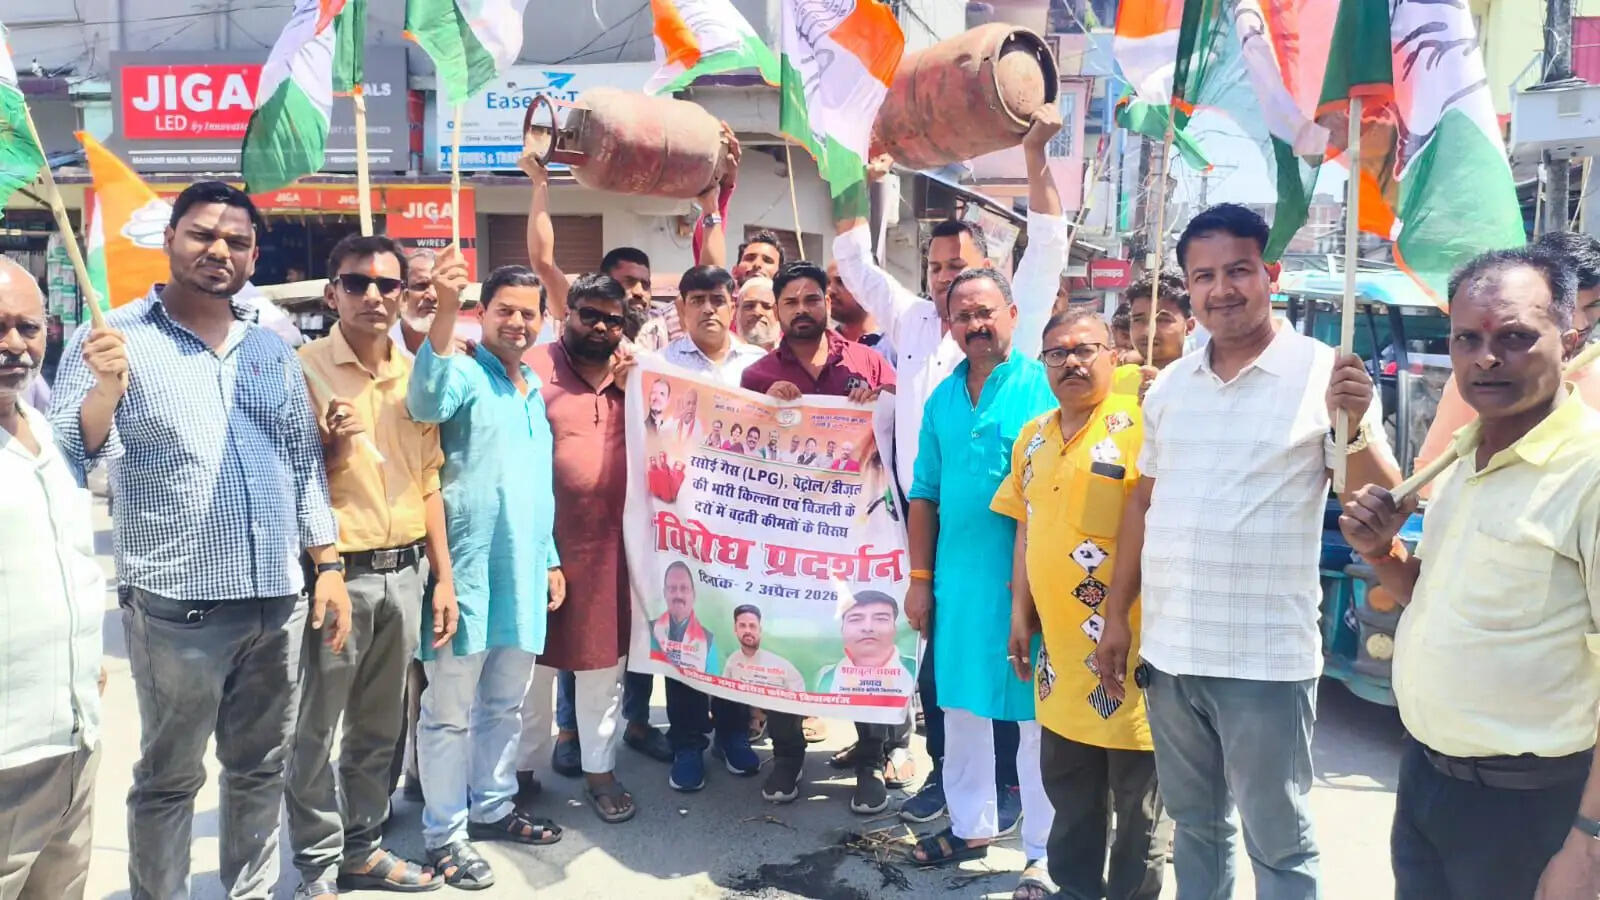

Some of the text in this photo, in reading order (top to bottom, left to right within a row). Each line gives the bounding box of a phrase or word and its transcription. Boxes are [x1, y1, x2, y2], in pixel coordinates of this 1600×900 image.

[132, 73, 254, 112] JIGA
[363, 83, 392, 96] ALS
[487, 91, 579, 112] EaseMyT
[155, 115, 187, 131] LED
[191, 121, 203, 134] by
[275, 191, 300, 203] JIGA
[402, 202, 453, 219] JIGA
[416, 239, 447, 248] WIRES
[690, 455, 718, 473] रसोई
[720, 458, 741, 477] गैस
[692, 477, 709, 492] की
[738, 486, 780, 507] किल्लत
[782, 496, 802, 512] एवं
[802, 498, 843, 517] बिजली
[844, 502, 857, 517] के
[694, 500, 715, 515] दरों
[715, 501, 729, 518] में
[760, 513, 801, 532] कीमतों
[801, 520, 815, 533] के
[651, 510, 905, 583] विरोध प्रदर्शन
[745, 581, 754, 592] 2
[803, 589, 839, 601] 2026
